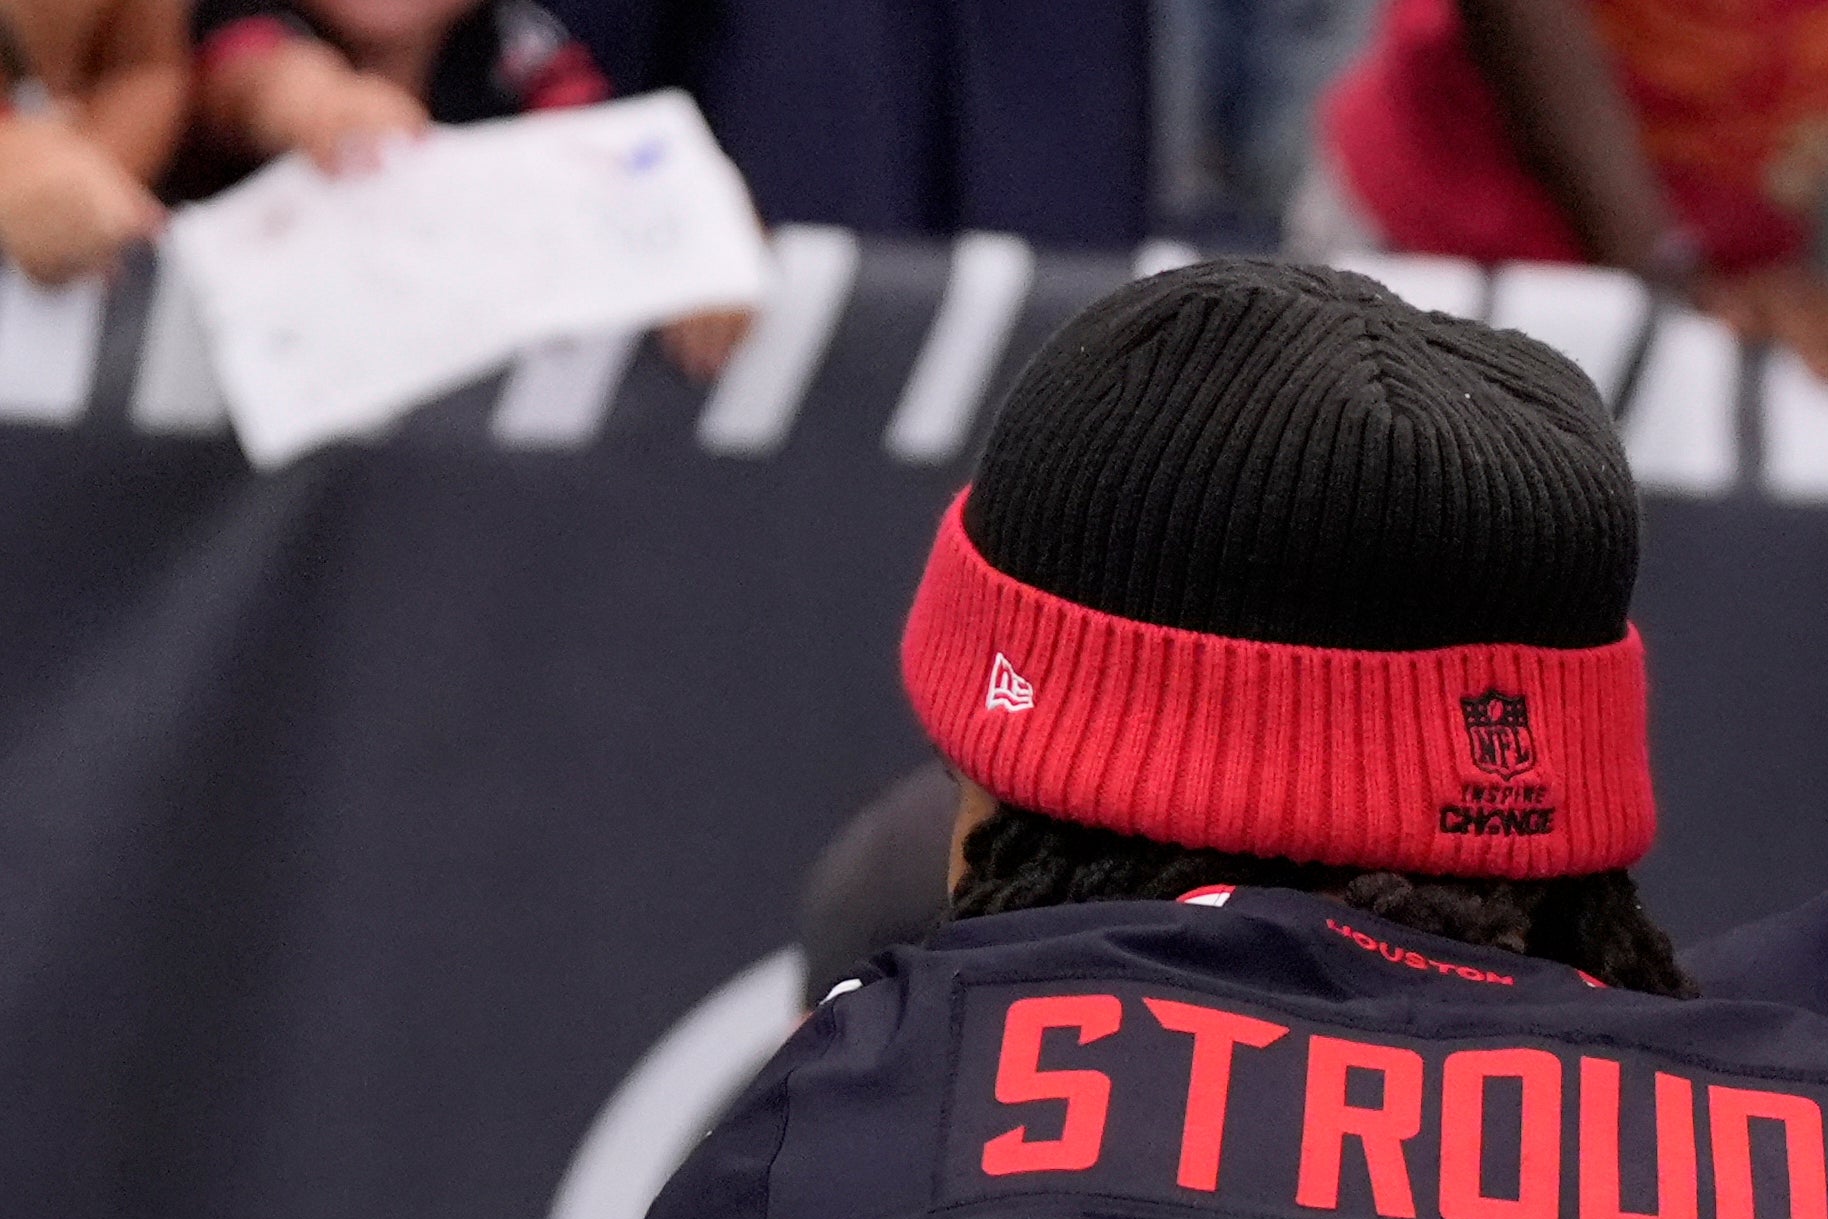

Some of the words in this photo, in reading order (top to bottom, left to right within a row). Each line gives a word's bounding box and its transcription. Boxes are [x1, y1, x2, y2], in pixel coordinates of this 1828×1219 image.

[1476, 726, 1531, 767] NFL
[1439, 804, 1556, 836] CHANGE
[1326, 918, 1515, 986] HOUSTON
